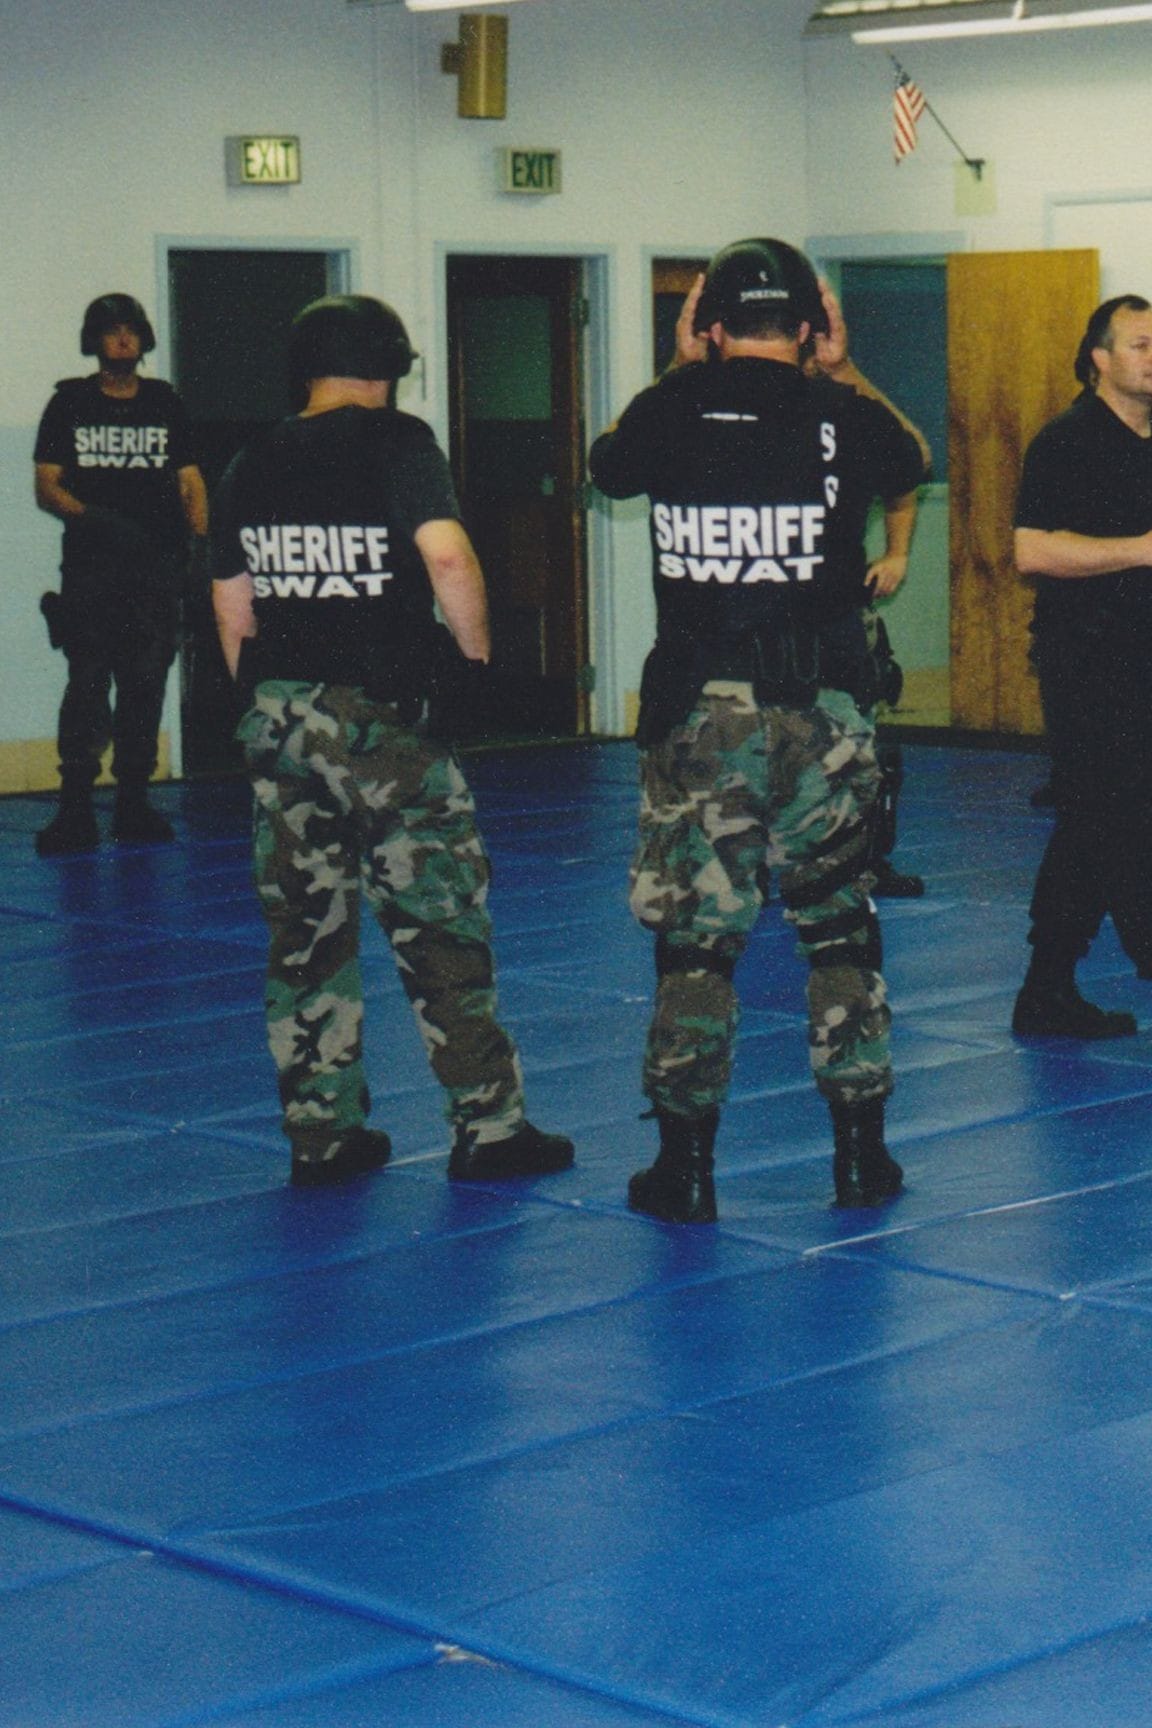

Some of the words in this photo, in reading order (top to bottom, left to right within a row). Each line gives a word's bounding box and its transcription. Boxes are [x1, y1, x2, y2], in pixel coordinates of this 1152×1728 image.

[243, 141, 294, 179] EXIT
[511, 151, 556, 188] EXIT
[75, 425, 168, 453] SHERIFF
[78, 453, 169, 469] SWAT
[653, 503, 825, 557] SHERIFF
[240, 525, 389, 573] SHERIFF
[659, 553, 824, 583] SWAT
[253, 572, 393, 598] SWAT
